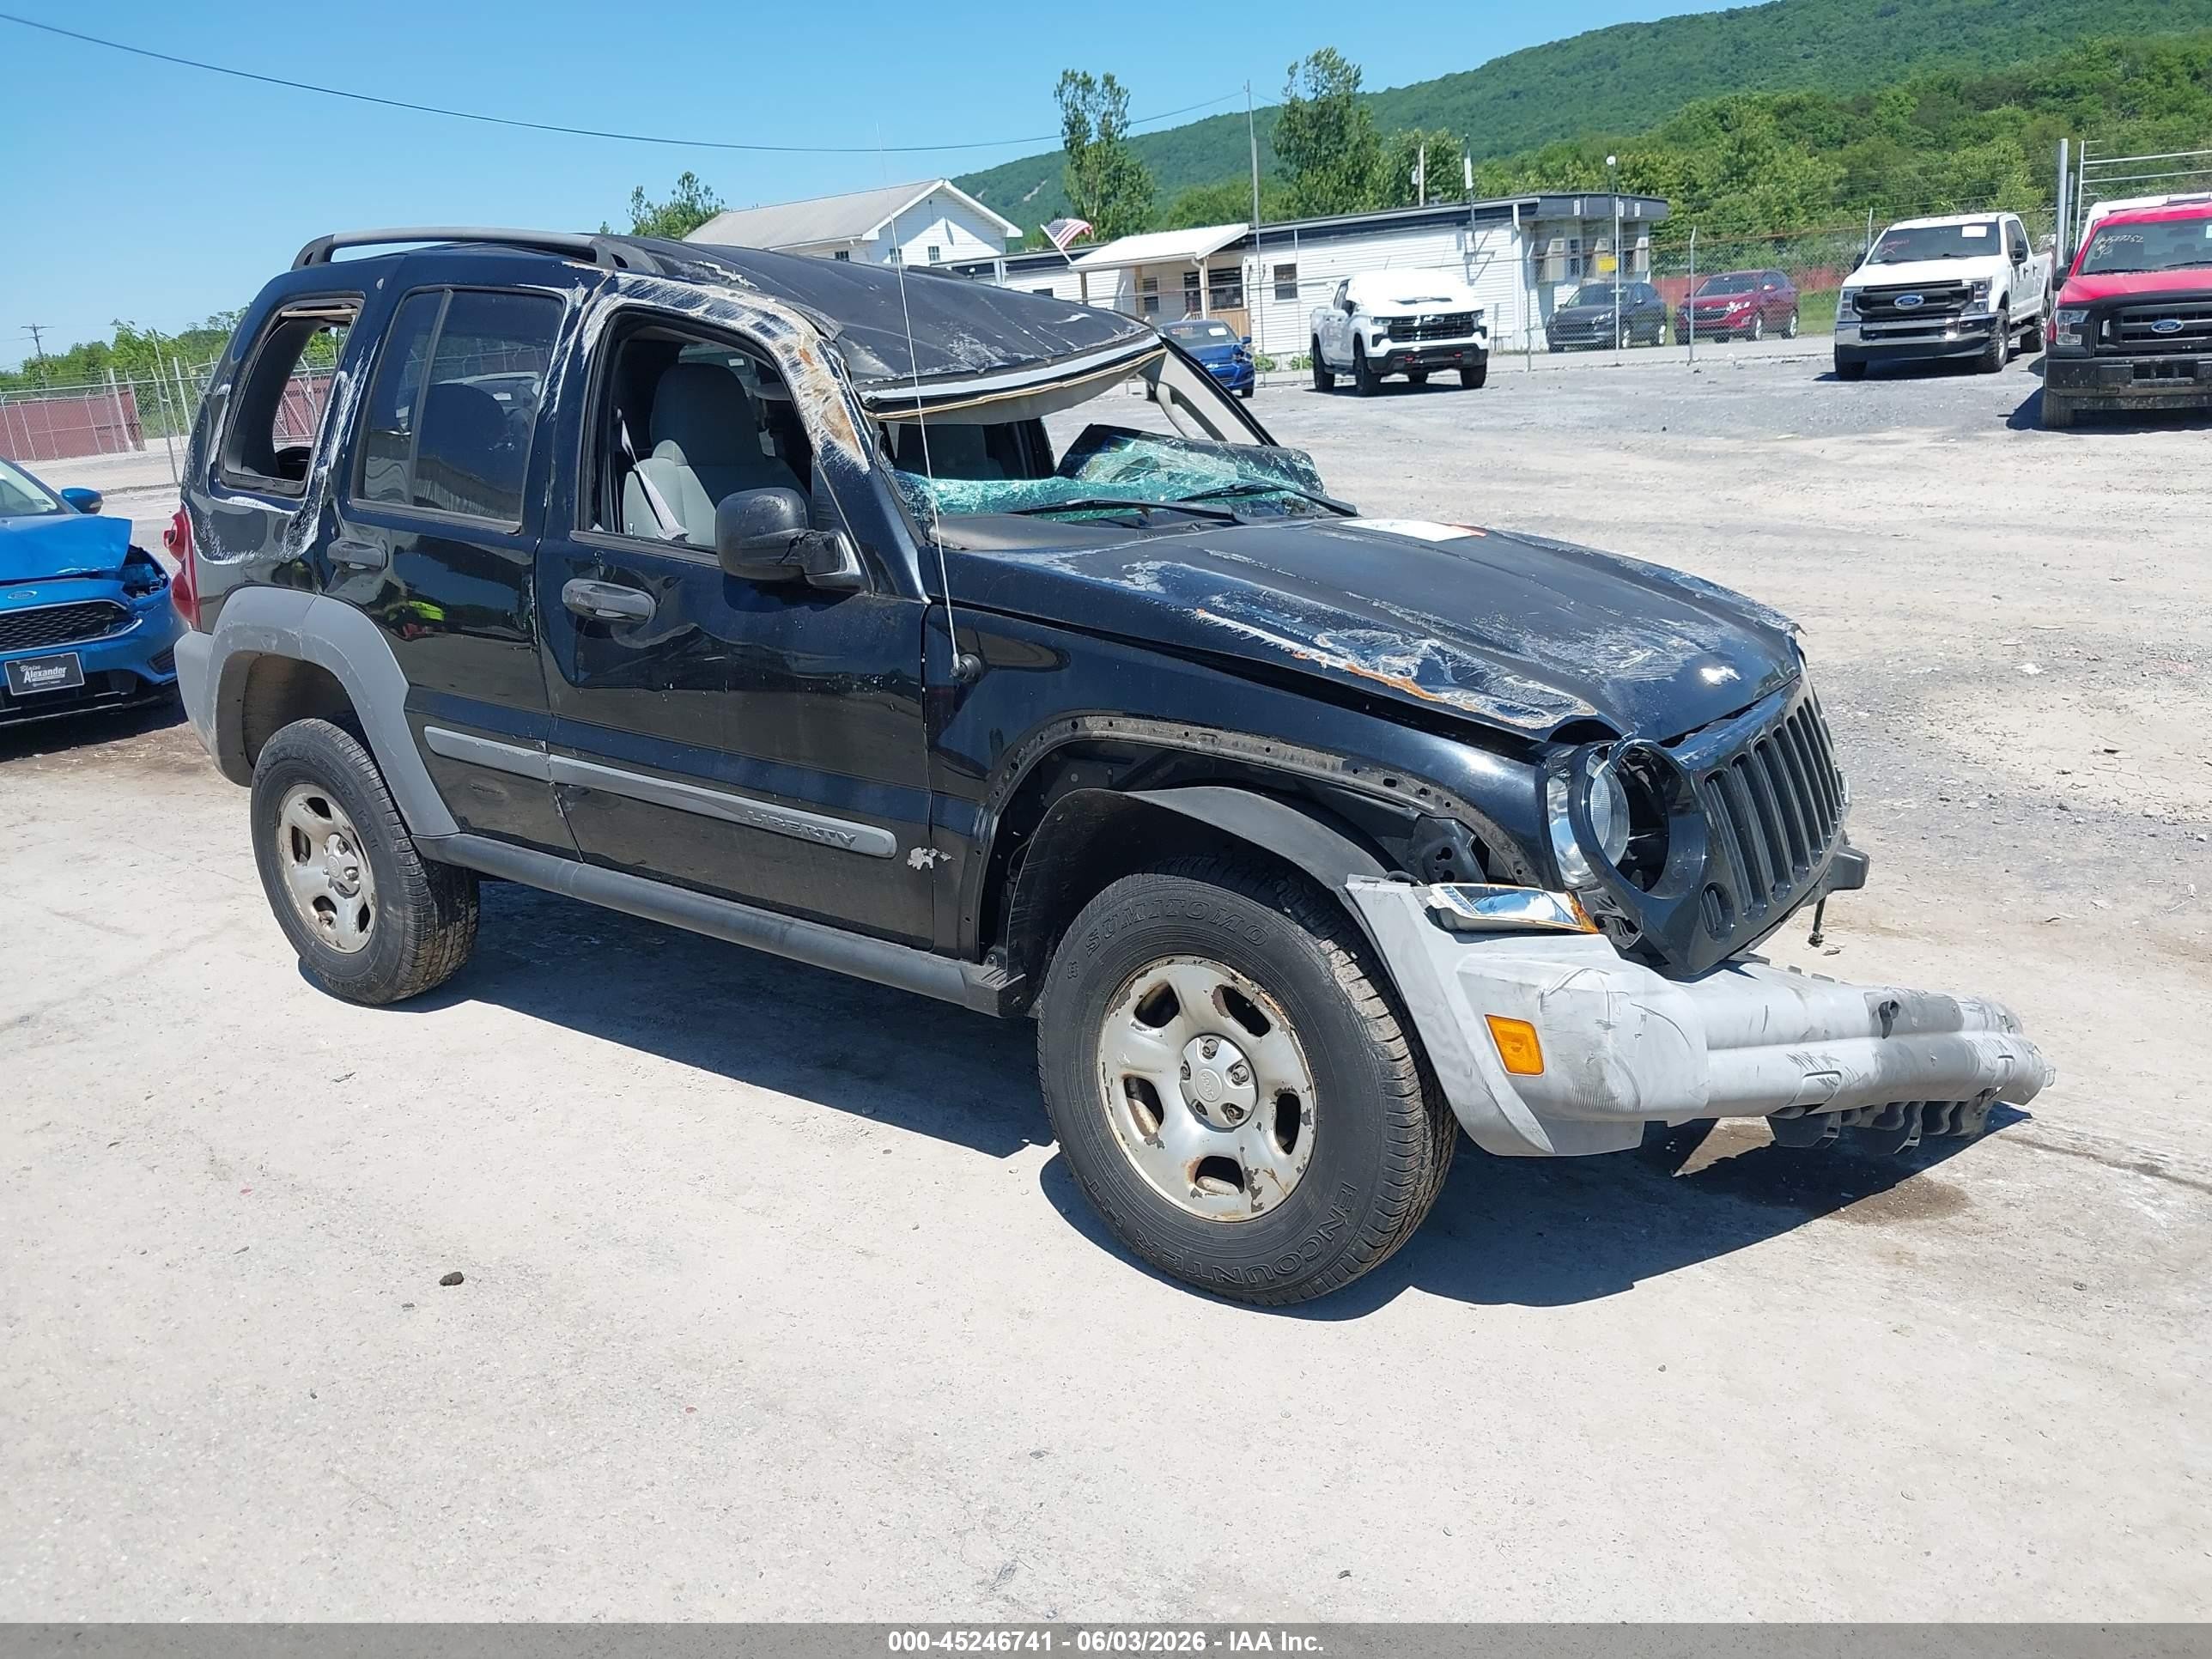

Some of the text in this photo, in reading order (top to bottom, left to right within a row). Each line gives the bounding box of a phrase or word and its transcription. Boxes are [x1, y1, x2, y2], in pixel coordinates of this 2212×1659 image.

[23, 666, 68, 684] Alexander
[744, 810, 857, 848] LIBERTY
[1085, 898, 1270, 957] SUMITOMO
[1135, 1181, 1359, 1285] ENCOUNTER
